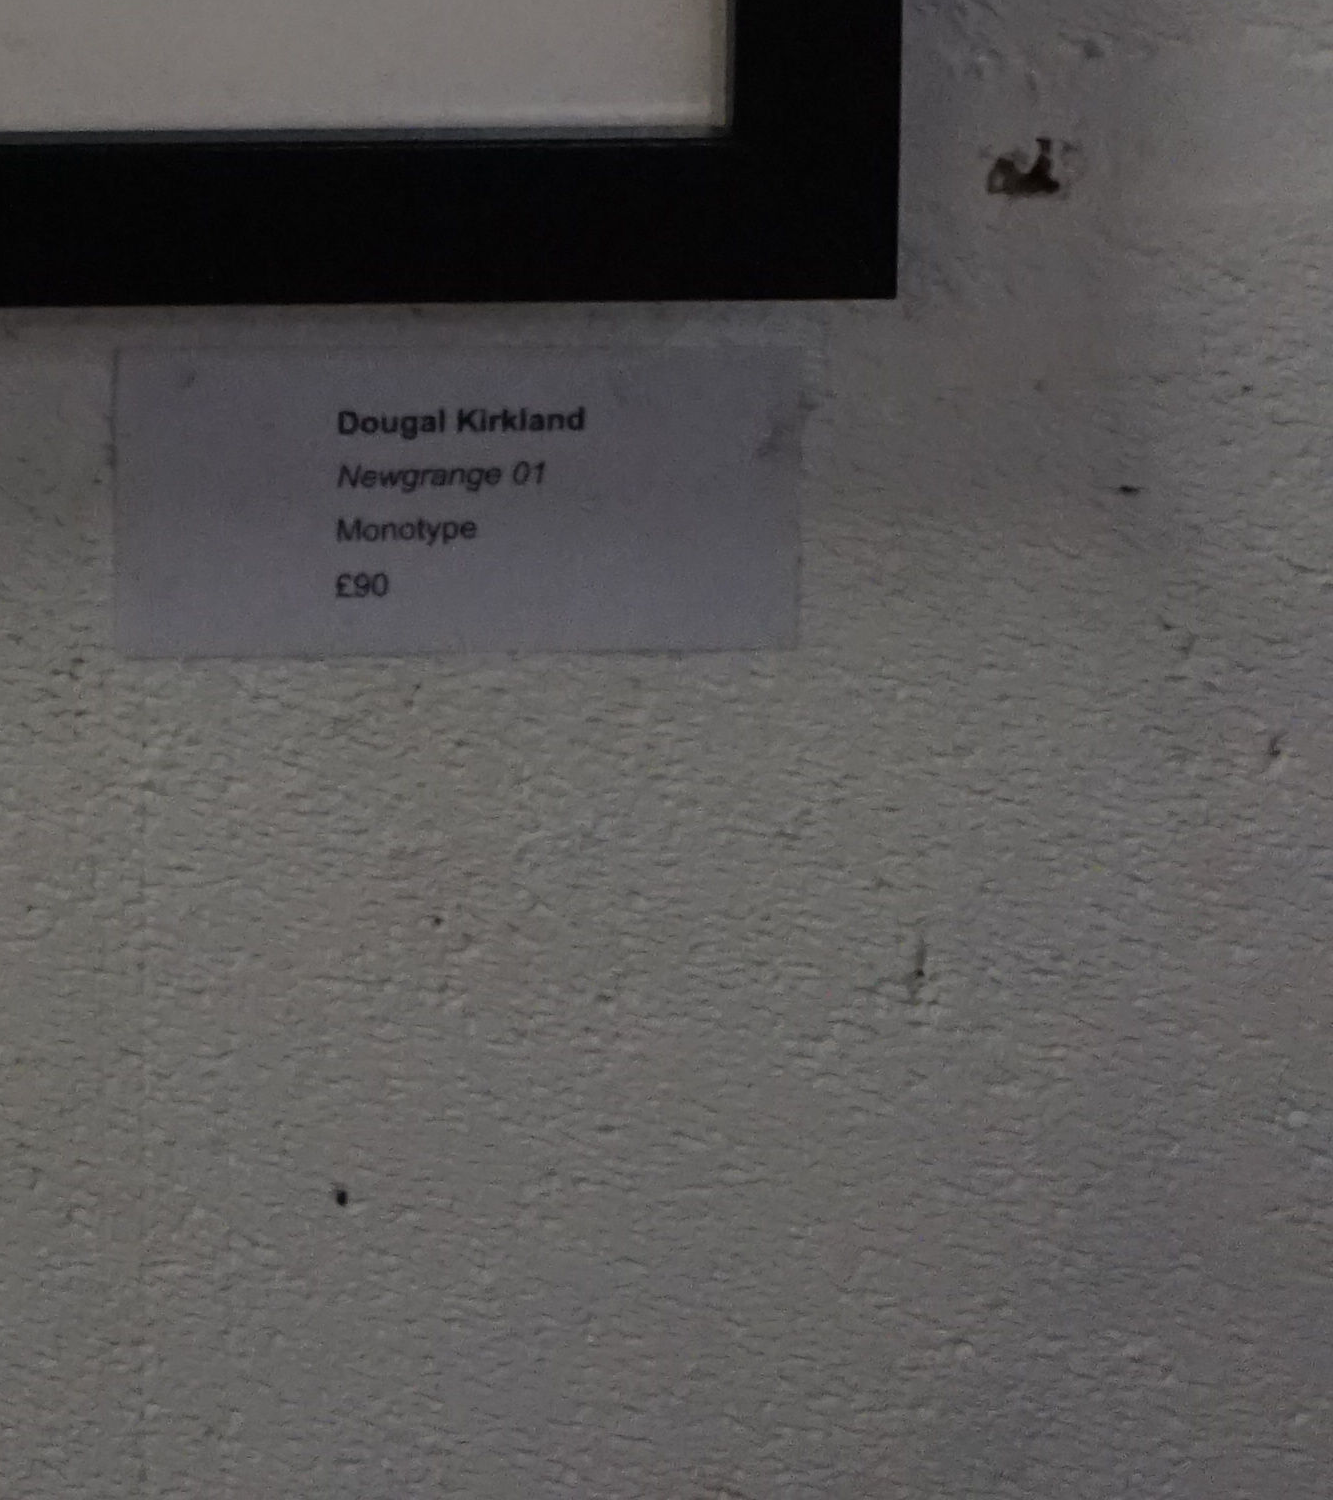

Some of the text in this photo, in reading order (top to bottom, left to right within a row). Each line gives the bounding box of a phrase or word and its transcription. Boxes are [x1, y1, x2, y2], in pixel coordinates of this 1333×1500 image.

[336, 405, 586, 440] Dougal Kirkland
[336, 461, 546, 493] Newgrange 01
[335, 516, 478, 544] Monotype
[334, 572, 390, 598] £90
